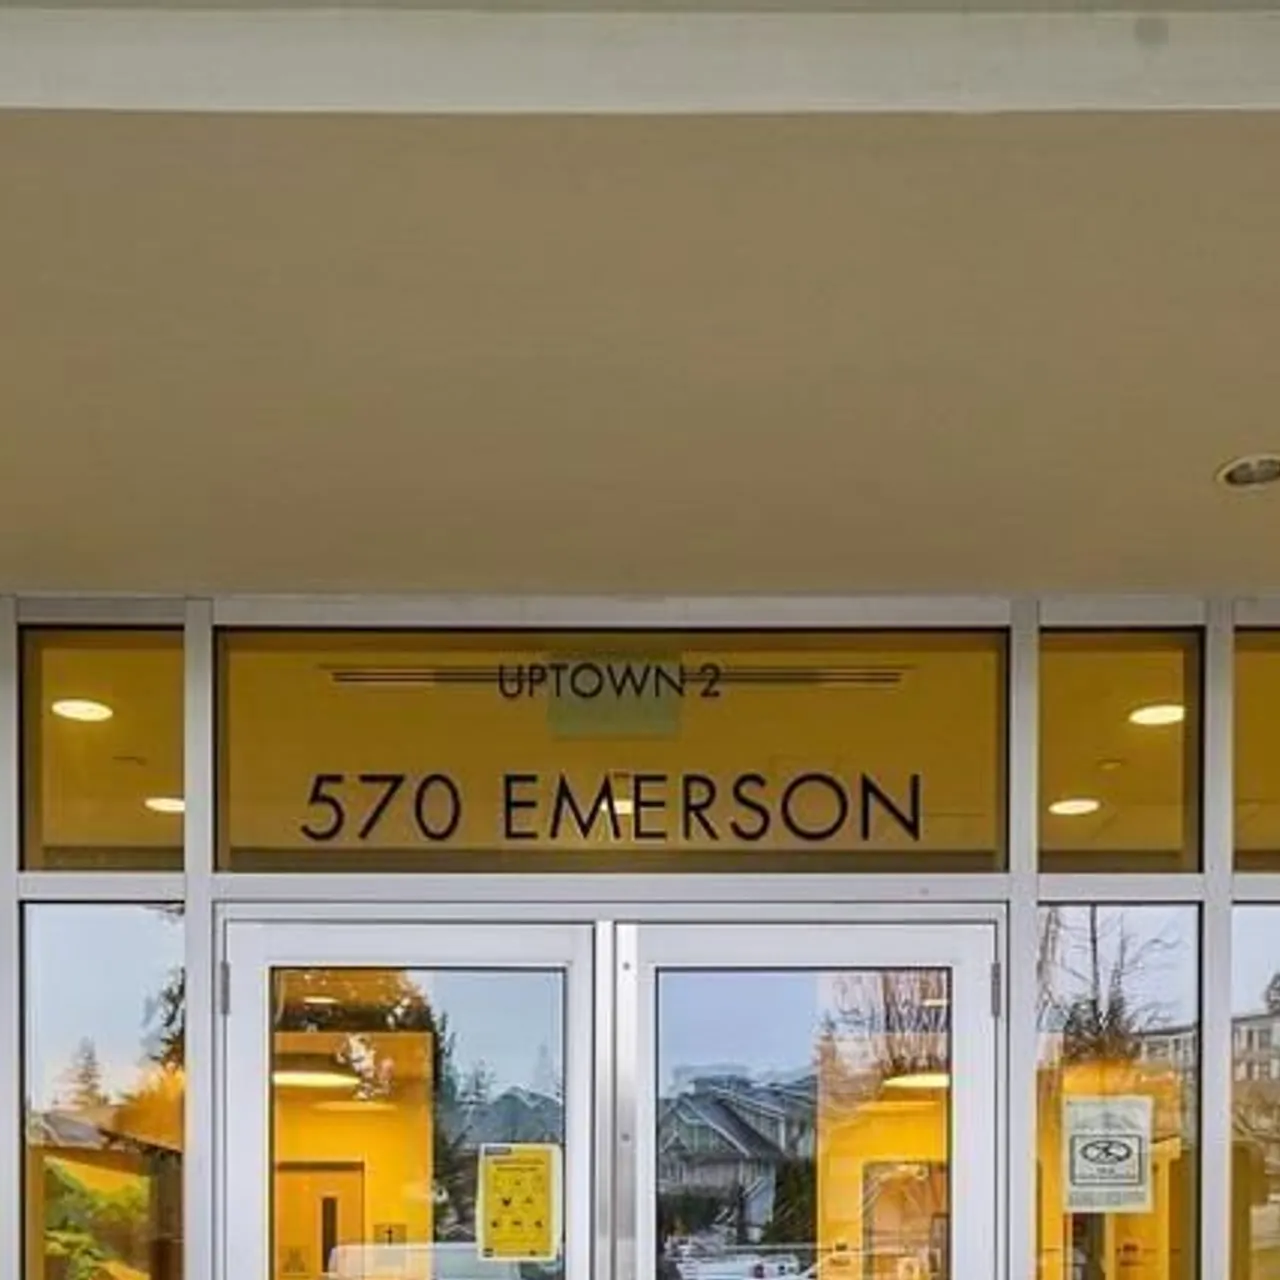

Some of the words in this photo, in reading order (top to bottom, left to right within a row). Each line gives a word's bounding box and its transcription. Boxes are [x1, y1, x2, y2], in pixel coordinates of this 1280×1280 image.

[497, 664, 687, 699] UPTOWN
[700, 663, 722, 698] 2
[300, 773, 462, 842] 570
[503, 773, 920, 842] EMERSON
